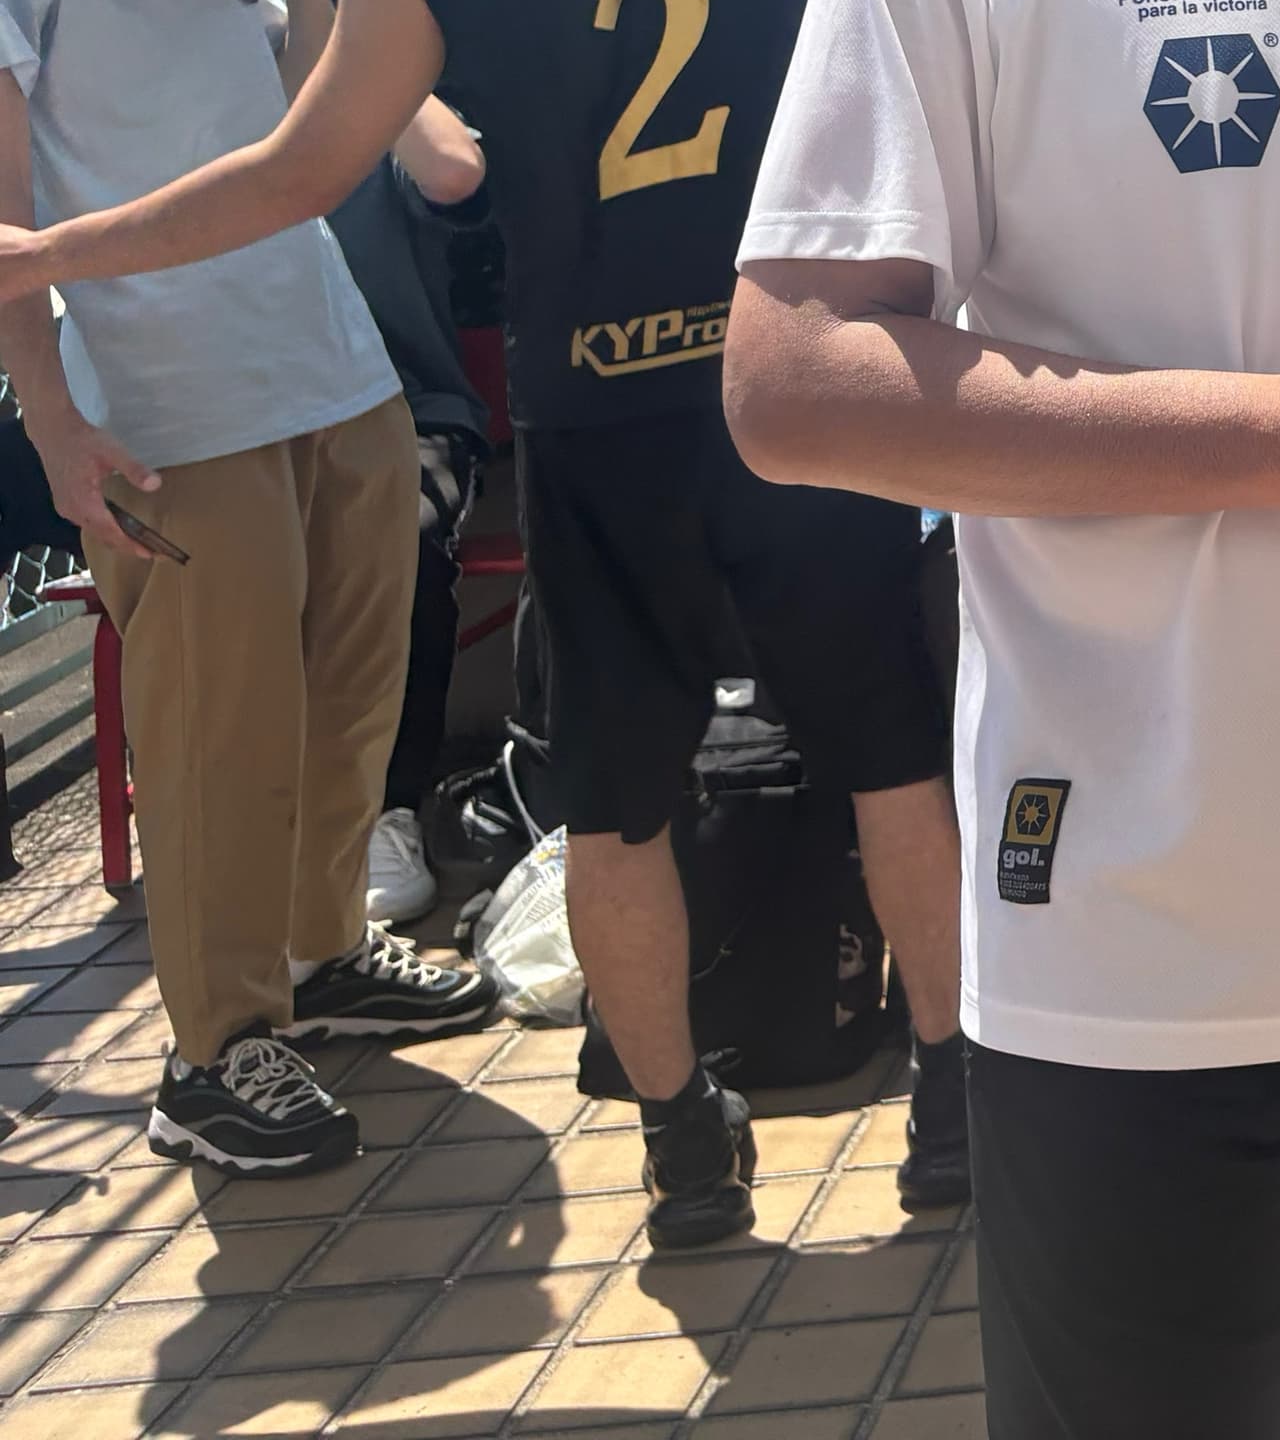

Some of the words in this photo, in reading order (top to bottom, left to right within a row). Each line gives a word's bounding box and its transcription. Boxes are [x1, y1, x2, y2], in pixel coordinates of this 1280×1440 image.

[1137, 2, 1179, 21] para
[1181, 0, 1199, 15] la
[1003, 848, 1045, 869] gol.
